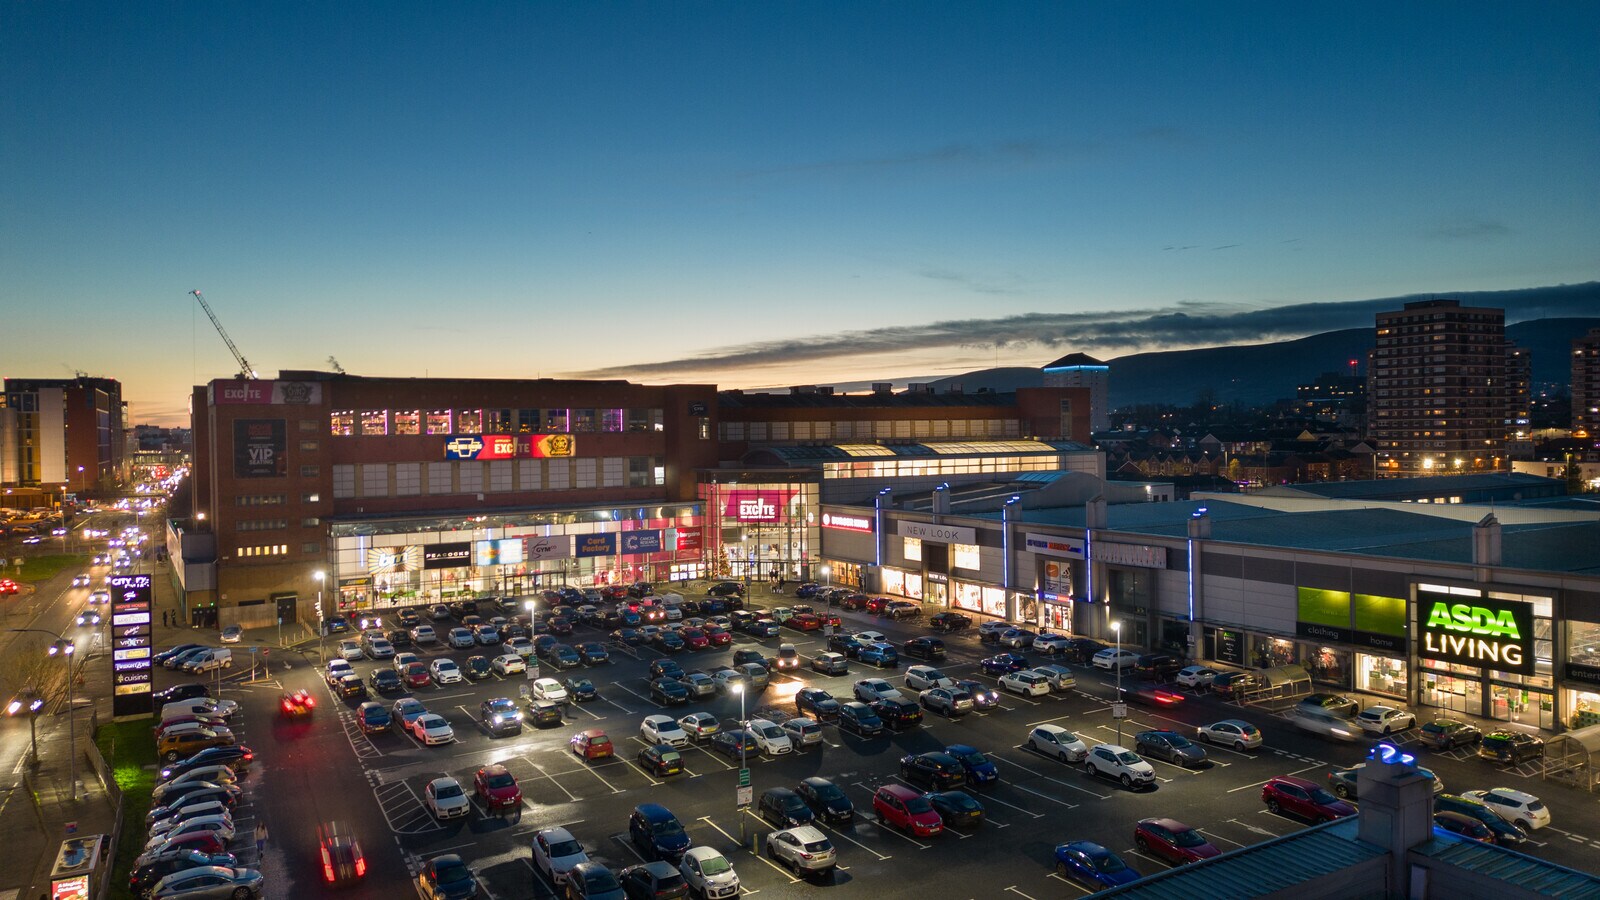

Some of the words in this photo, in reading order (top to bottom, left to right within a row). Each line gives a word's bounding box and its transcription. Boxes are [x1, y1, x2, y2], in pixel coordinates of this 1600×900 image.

[249, 448, 273, 460] VIP
[907, 526, 927, 536] NEW
[931, 530, 959, 540] LOOK
[582, 544, 610, 552] Factory
[1427, 602, 1521, 640] ASDA
[1308, 626, 1339, 640] clothing
[1370, 636, 1393, 647] home
[1425, 632, 1522, 665] LIVING
[124, 674, 148, 682] cuisine
